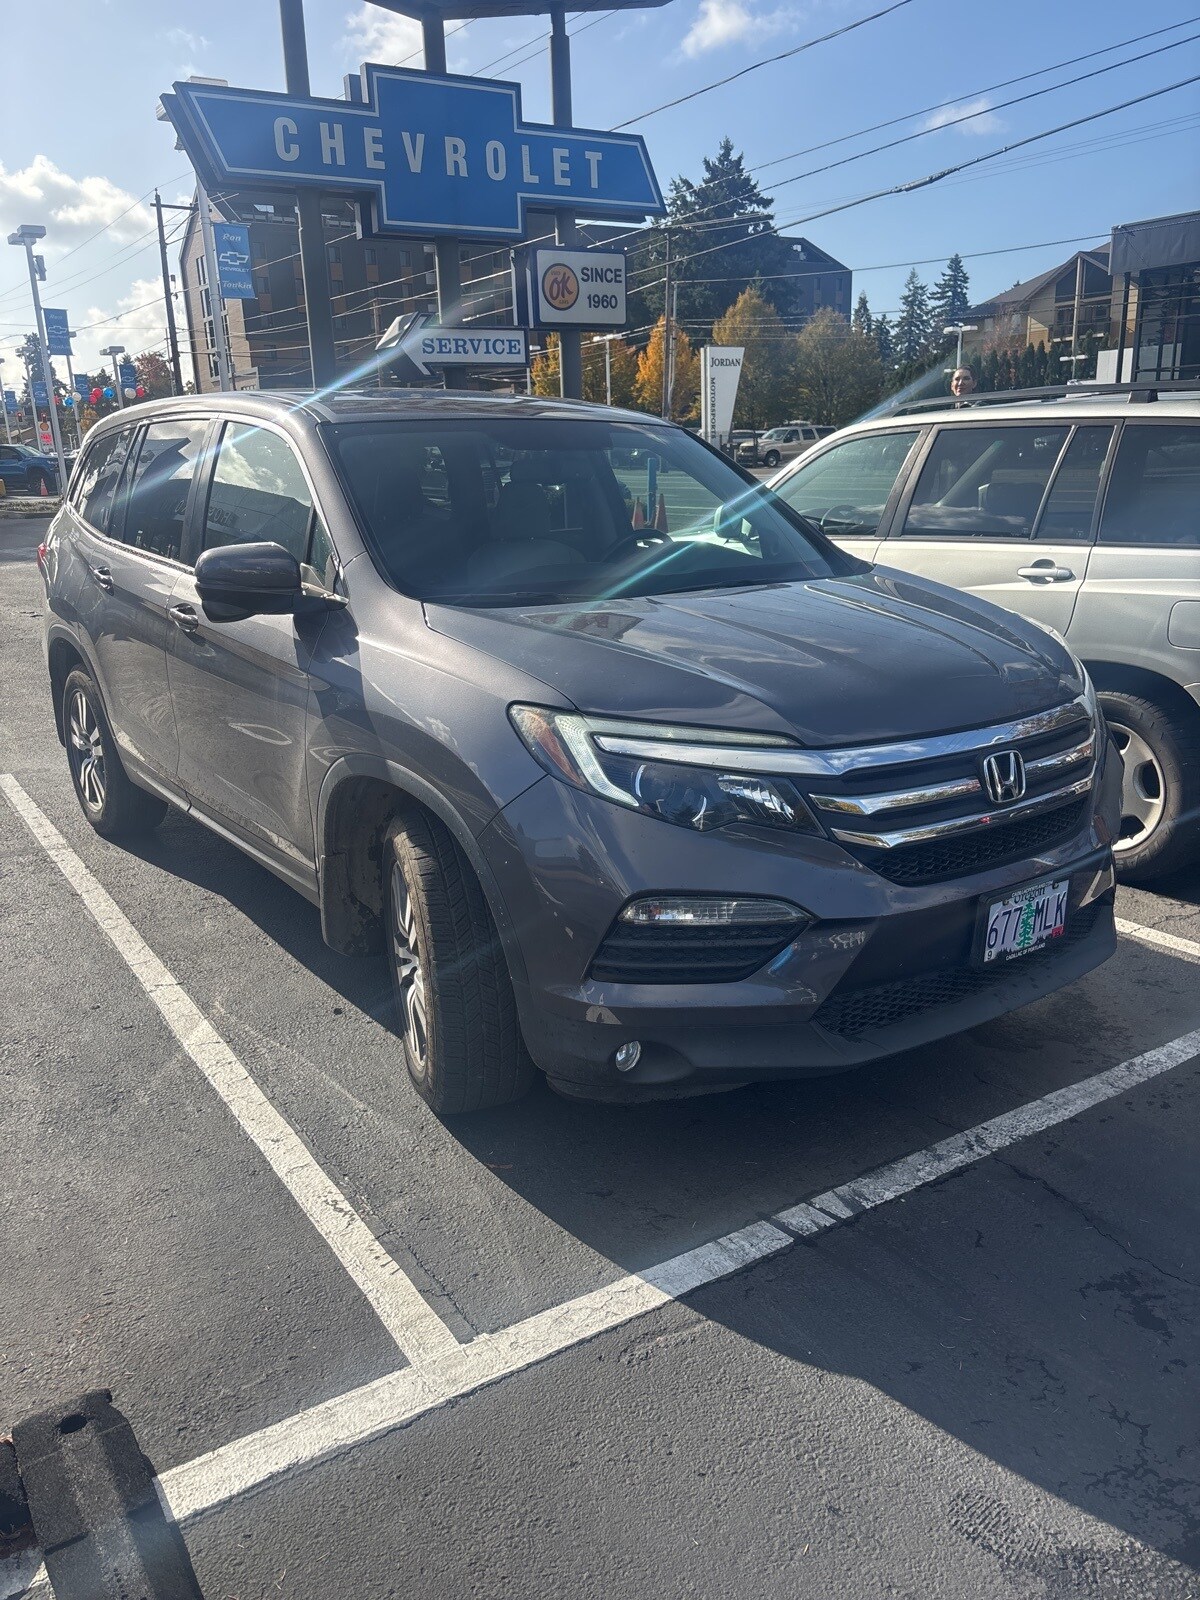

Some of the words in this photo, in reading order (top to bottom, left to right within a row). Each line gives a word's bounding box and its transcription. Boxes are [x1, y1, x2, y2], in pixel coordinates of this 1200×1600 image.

[273, 116, 603, 190] CHEVROLET
[222, 233, 242, 242] Ron
[580, 267, 622, 283] SINCE
[222, 280, 252, 289] Tonkin
[549, 272, 573, 300] OK
[587, 294, 618, 309] 1960
[421, 336, 522, 356] SERVICE
[711, 357, 741, 367] JORDAN
[986, 906, 1024, 949] 677
[1032, 891, 1067, 935] MLK
